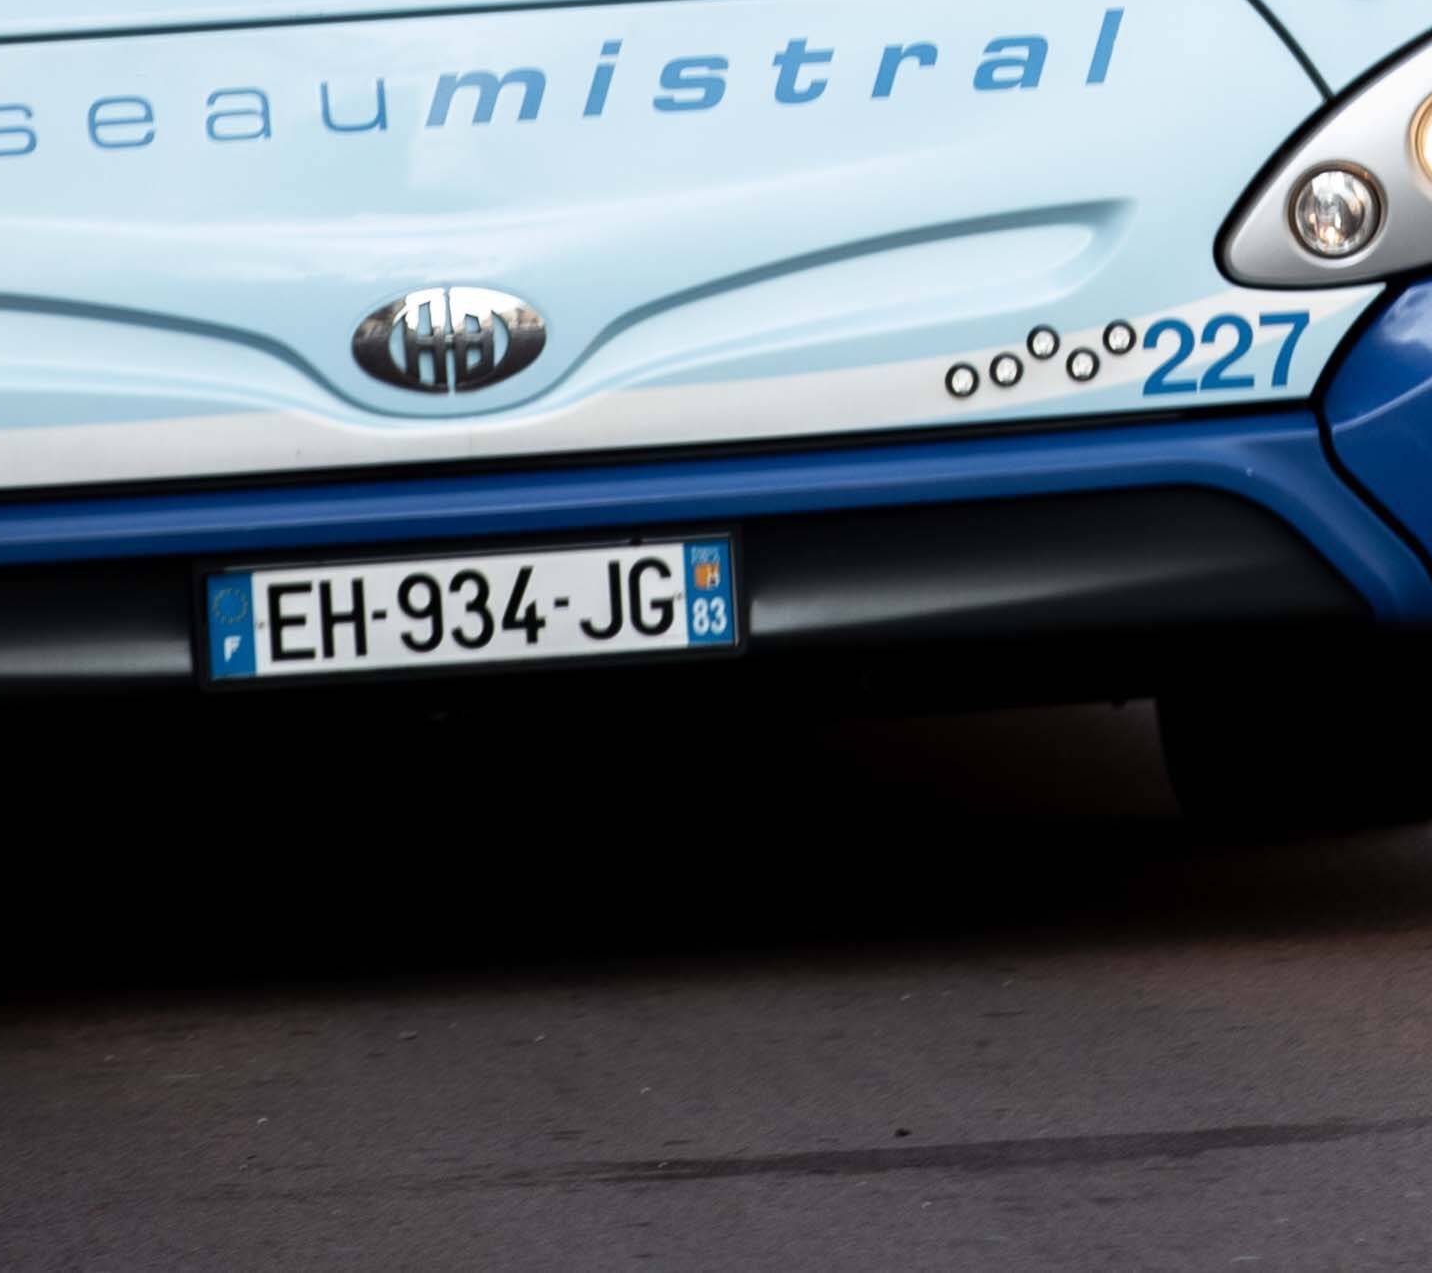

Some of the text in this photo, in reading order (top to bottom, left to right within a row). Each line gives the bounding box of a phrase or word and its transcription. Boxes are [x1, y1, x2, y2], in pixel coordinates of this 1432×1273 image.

[1141, 310, 1311, 396] 227
[267, 556, 676, 663] EH-934-JG
[692, 596, 729, 636] 83
